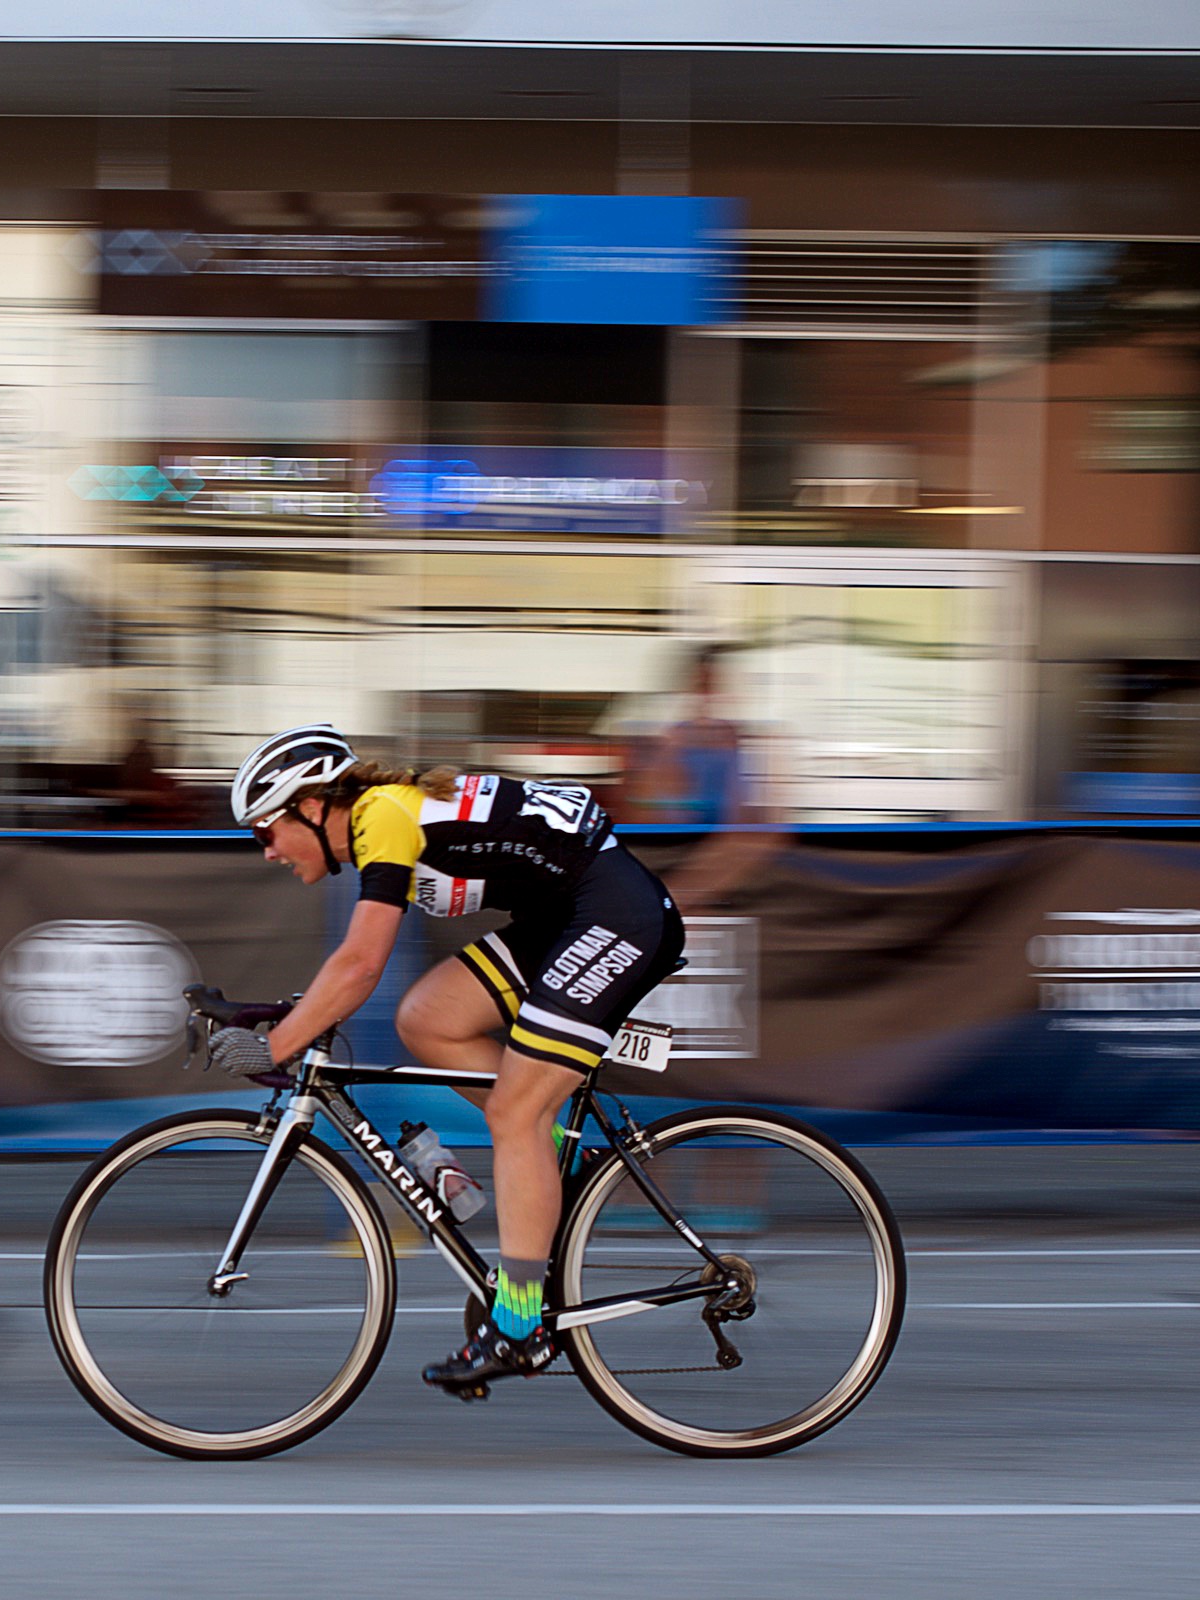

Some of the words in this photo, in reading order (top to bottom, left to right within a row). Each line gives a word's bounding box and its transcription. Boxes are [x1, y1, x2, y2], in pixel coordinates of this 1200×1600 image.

[542, 925, 618, 991] GLOTMAN
[566, 941, 644, 1005] SIMPSON
[617, 1032, 651, 1062] 218
[353, 1120, 443, 1224] MARIN
